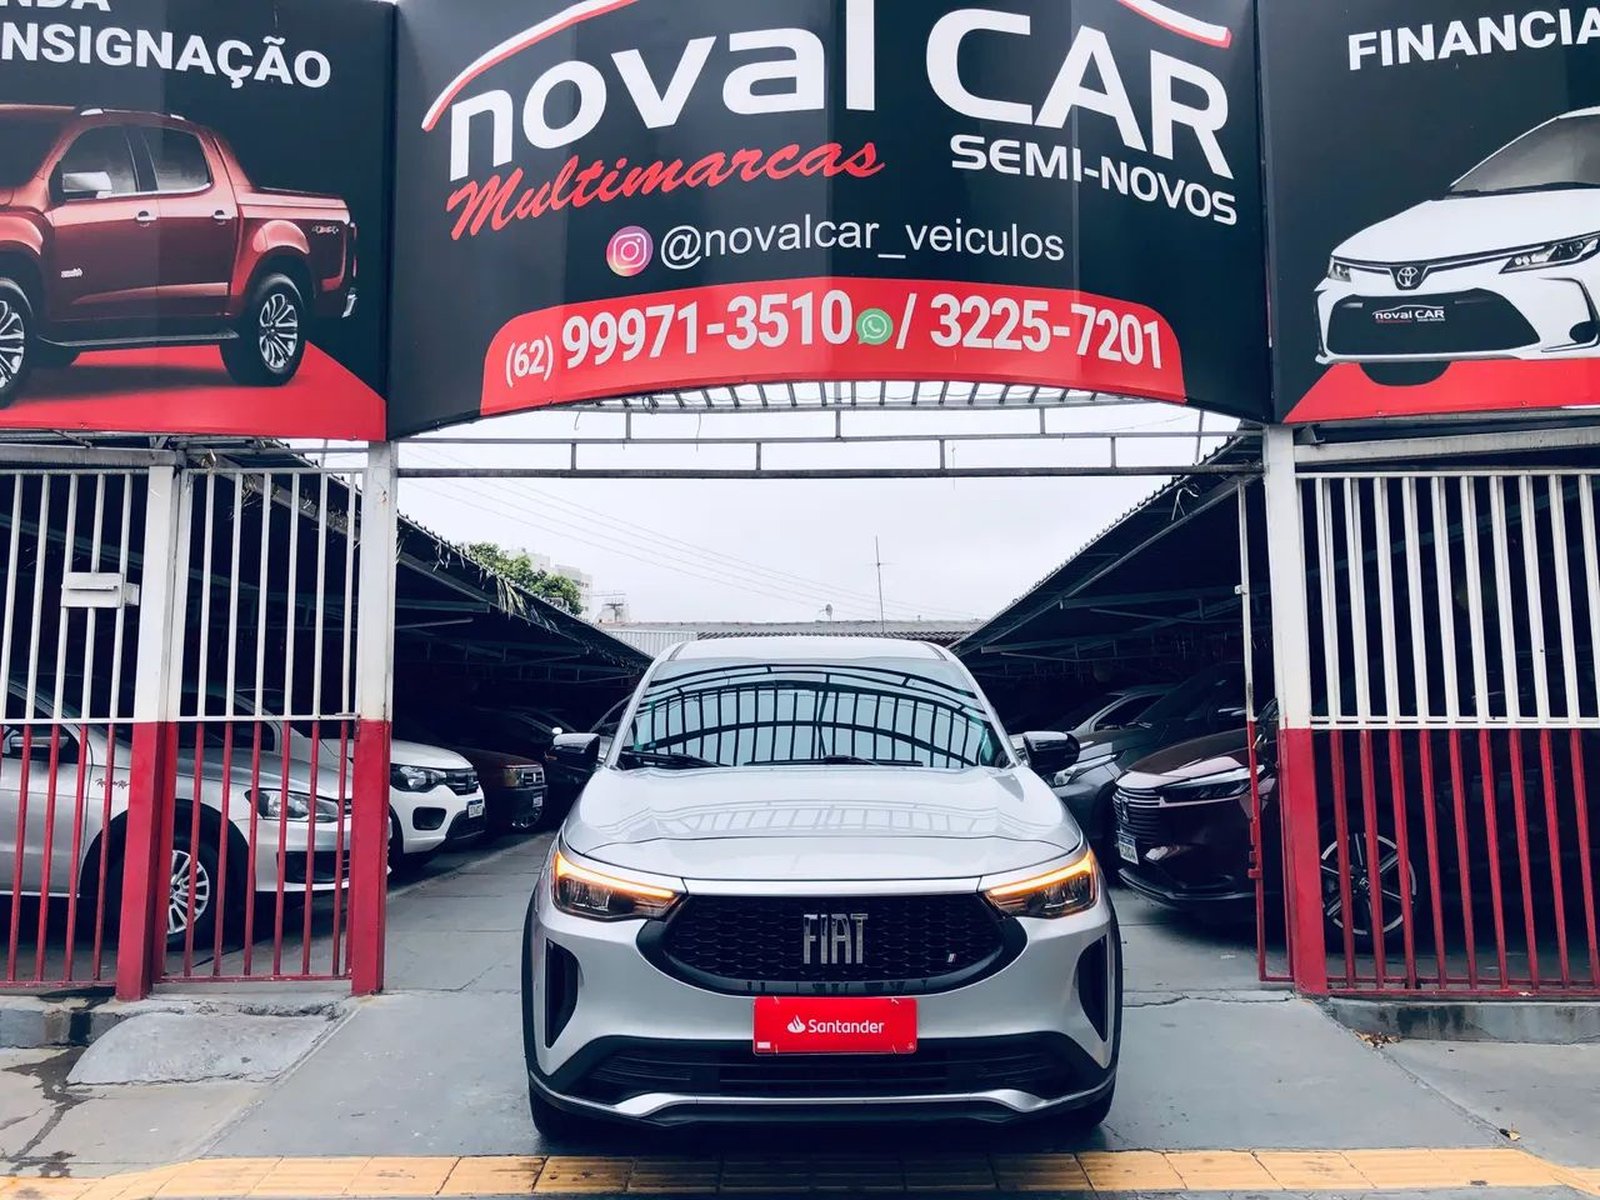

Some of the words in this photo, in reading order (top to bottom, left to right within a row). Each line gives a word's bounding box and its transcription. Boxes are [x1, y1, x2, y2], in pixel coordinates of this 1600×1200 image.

[450, 0, 875, 181] noval
[926, 8, 1234, 179] CAR
[446, 141, 885, 240] Multimarcas
[950, 134, 1237, 226] SEMI-NOVOS
[660, 214, 1064, 270] @novalcar_veiculos
[505, 335, 554, 387] (62)
[562, 289, 853, 370] 99971-3510
[930, 293, 1162, 369] 3225-7201
[1375, 310, 1412, 319] noval
[1415, 309, 1445, 318] CAR
[803, 913, 868, 964] FIAT
[808, 1019, 885, 1034] Santander
